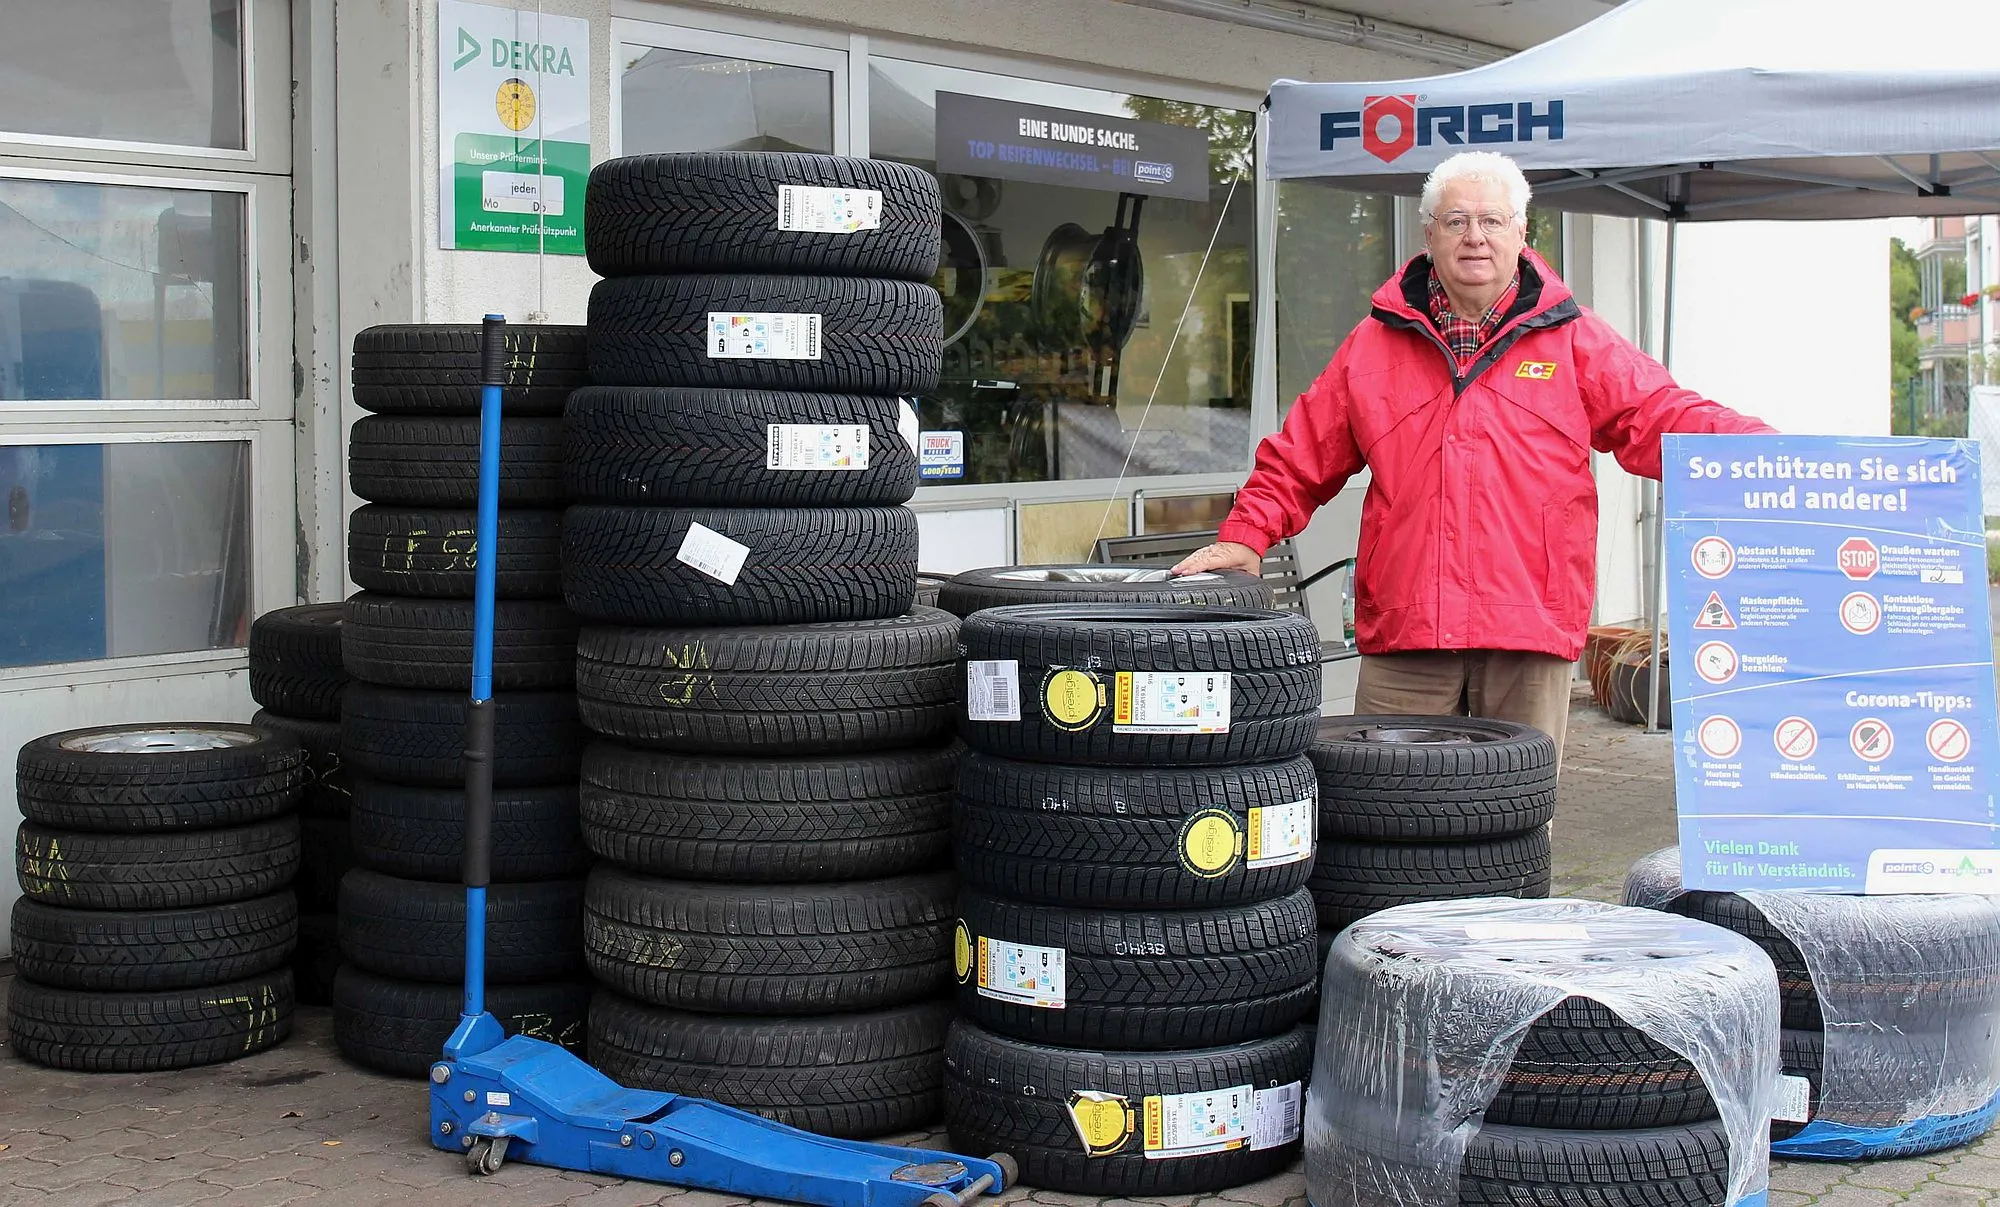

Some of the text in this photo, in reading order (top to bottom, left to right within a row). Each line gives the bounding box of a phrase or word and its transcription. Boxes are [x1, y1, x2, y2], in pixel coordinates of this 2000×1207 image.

[491, 38, 575, 77] DEKRA
[1019, 118, 1139, 152] EINE RUNDE SACHE.
[470, 149, 499, 161] Unsere
[968, 140, 995, 160] TOP
[999, 143, 1100, 173] REIFENWECHSEL
[511, 182, 537, 195] jeden
[484, 197, 499, 209] Mo
[470, 221, 520, 234] Anerkannter
[926, 438, 950, 448] TRUCK
[922, 465, 961, 476] GOODYEAR
[1688, 455, 1957, 484] So schützen Sie sich
[1743, 485, 1908, 512] und andere!
[1737, 545, 1815, 556] Abstand halten:
[1881, 545, 1960, 557] Draußen warten:
[1841, 549, 1875, 568] STOP
[1930, 567, 1946, 584] 2
[1740, 596, 1803, 607] Maskenpflicht:
[1883, 594, 1934, 604] Kontaktlose
[1883, 604, 1964, 615] Fahrzeugübergabe:
[1741, 654, 1788, 665] Bargeldlos
[1741, 663, 1785, 673] bezahlen.
[1065, 673, 1077, 718] prestige
[1118, 676, 1128, 720] PIRELLI
[1845, 690, 1972, 713] Corona-Tipps:
[1927, 765, 1975, 773] Handkontakt
[1944, 774, 1971, 782] Gesicht
[1206, 819, 1217, 864] prestige
[1704, 840, 1799, 856] Vielen Dank
[1705, 861, 1856, 879] für Ihr Verständnis.
[1092, 1101, 1105, 1141] prestig
[1148, 1102, 1159, 1146] PIRELLI
